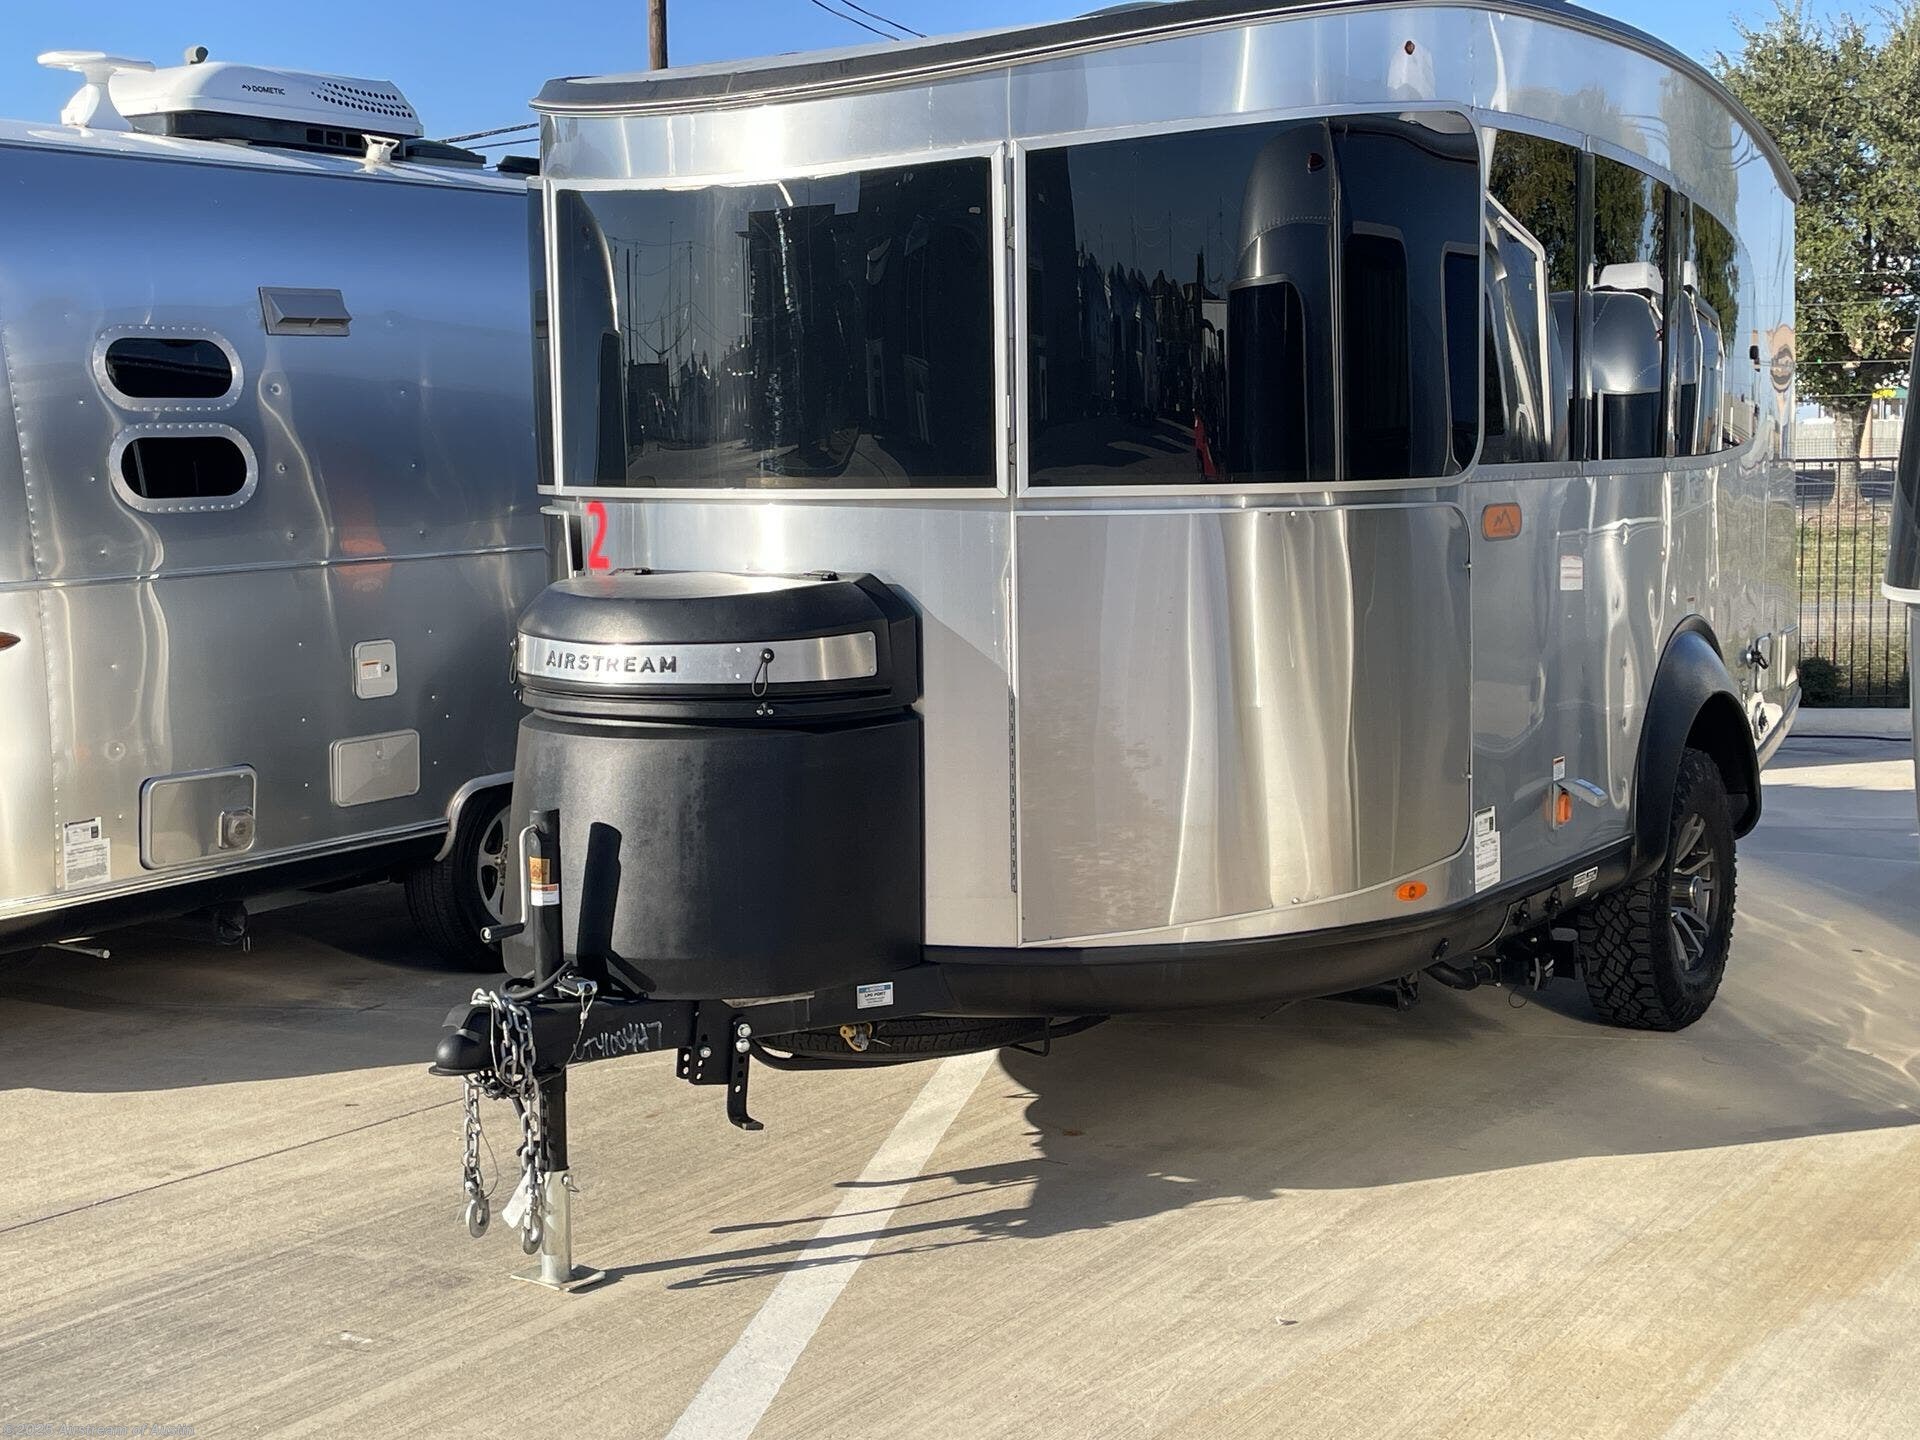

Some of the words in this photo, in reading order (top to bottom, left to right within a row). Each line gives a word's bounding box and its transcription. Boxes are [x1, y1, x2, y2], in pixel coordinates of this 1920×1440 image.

[252, 85, 286, 96] DOMETIC
[587, 500, 610, 570] 2
[546, 650, 677, 673] AIRSTREAM
